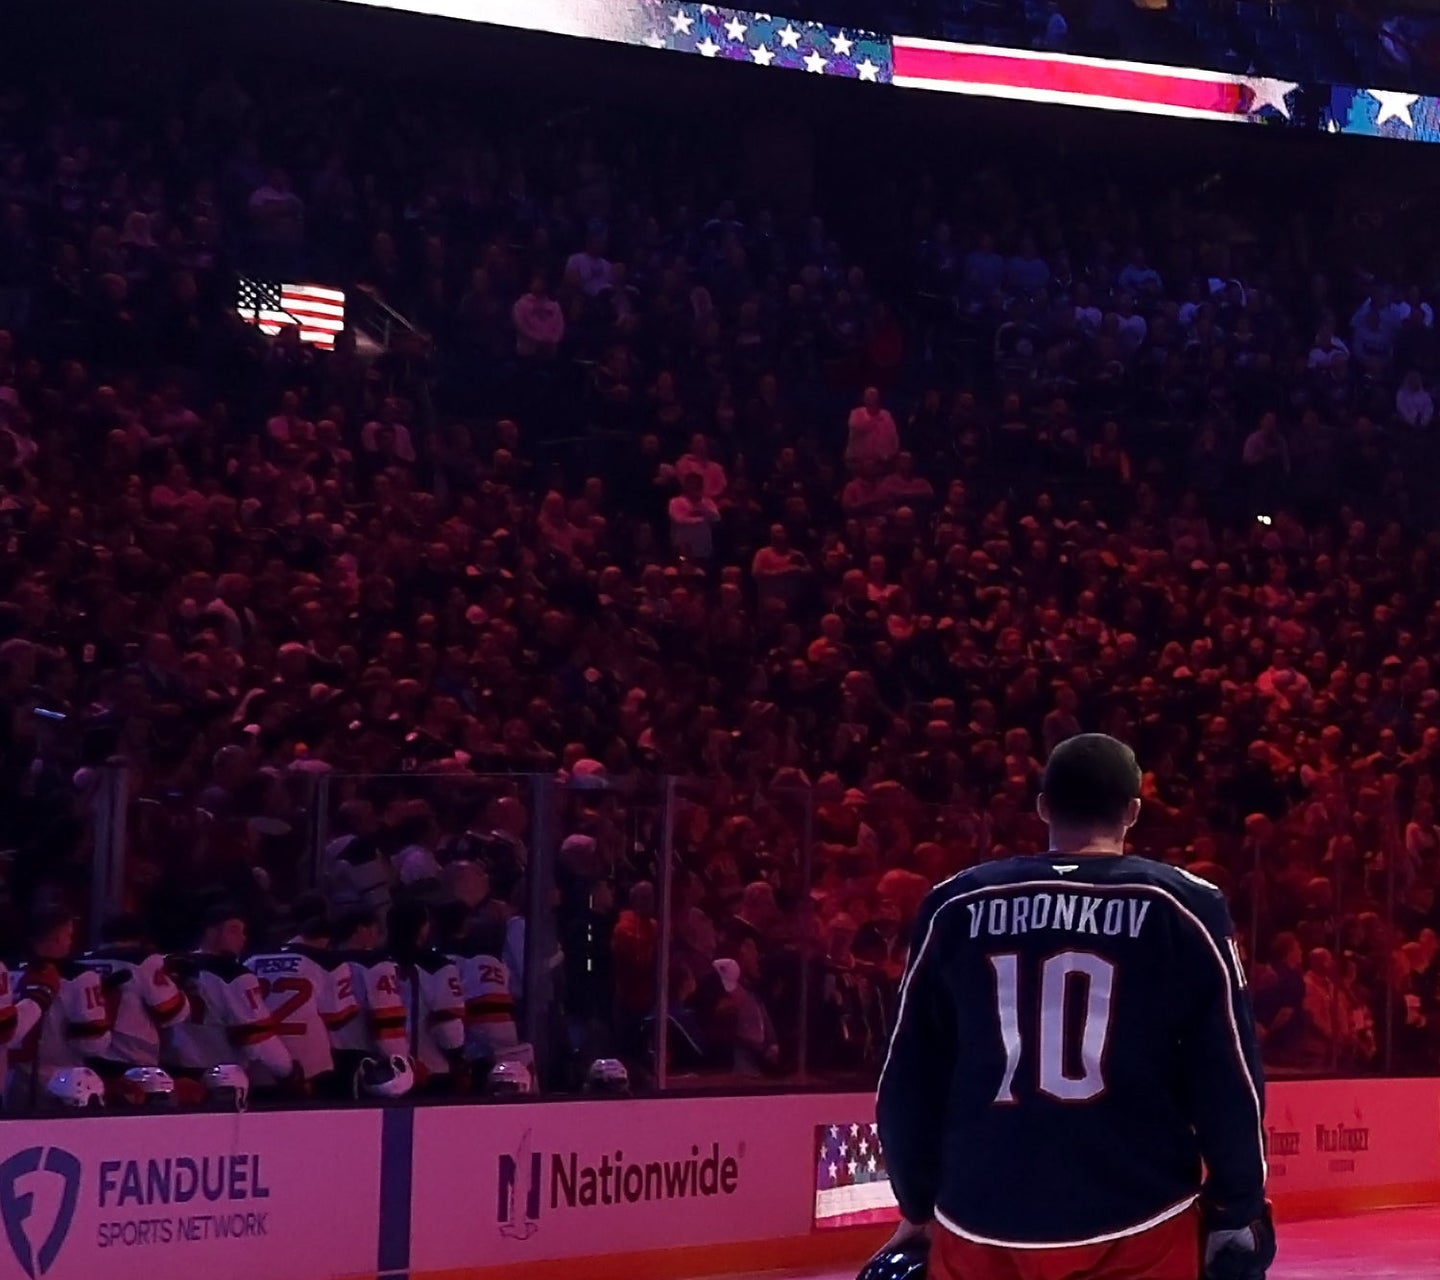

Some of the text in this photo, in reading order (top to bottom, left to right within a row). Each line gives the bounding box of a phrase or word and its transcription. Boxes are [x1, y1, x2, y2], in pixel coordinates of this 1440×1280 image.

[967, 894, 1151, 941] VORONKOV
[988, 951, 1115, 1106] 10
[98, 1154, 269, 1208] FANDUEL
[550, 1142, 738, 1209] Nationwide
[97, 1213, 268, 1248] SPORTS NETWORK
